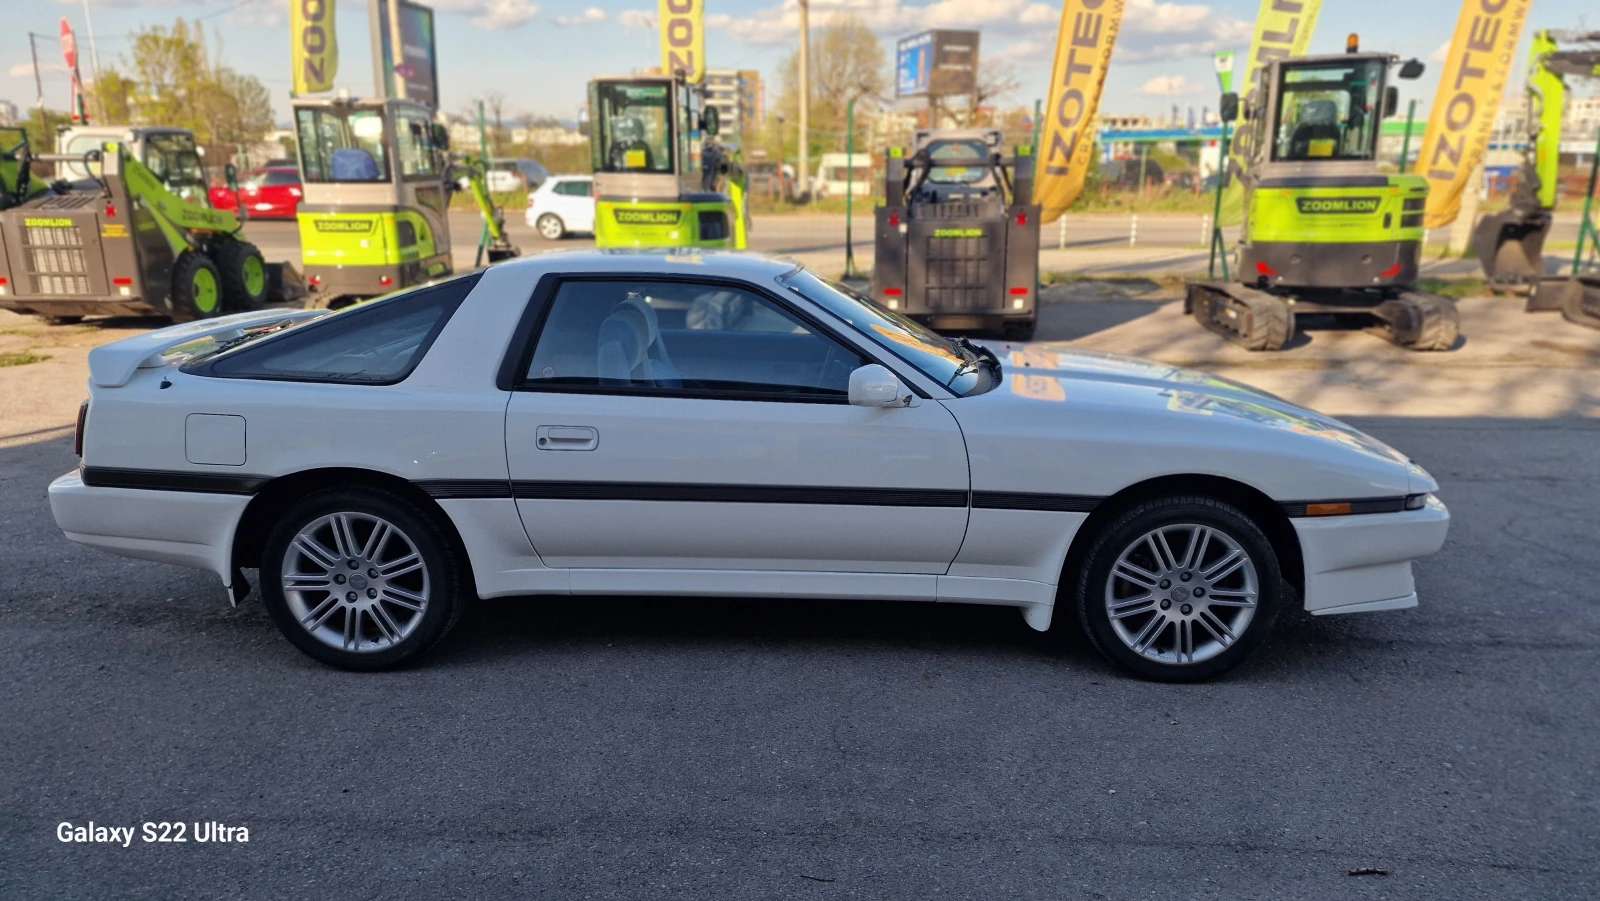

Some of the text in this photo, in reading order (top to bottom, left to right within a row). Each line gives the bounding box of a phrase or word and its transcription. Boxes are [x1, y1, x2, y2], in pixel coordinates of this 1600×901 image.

[1045, 0, 1105, 176] IZOTE
[1301, 200, 1377, 212] ZOOMLION
[24, 217, 72, 227] ZOOMLION
[617, 211, 678, 222] ZOOMLION
[317, 221, 370, 231] ZOOMLION
